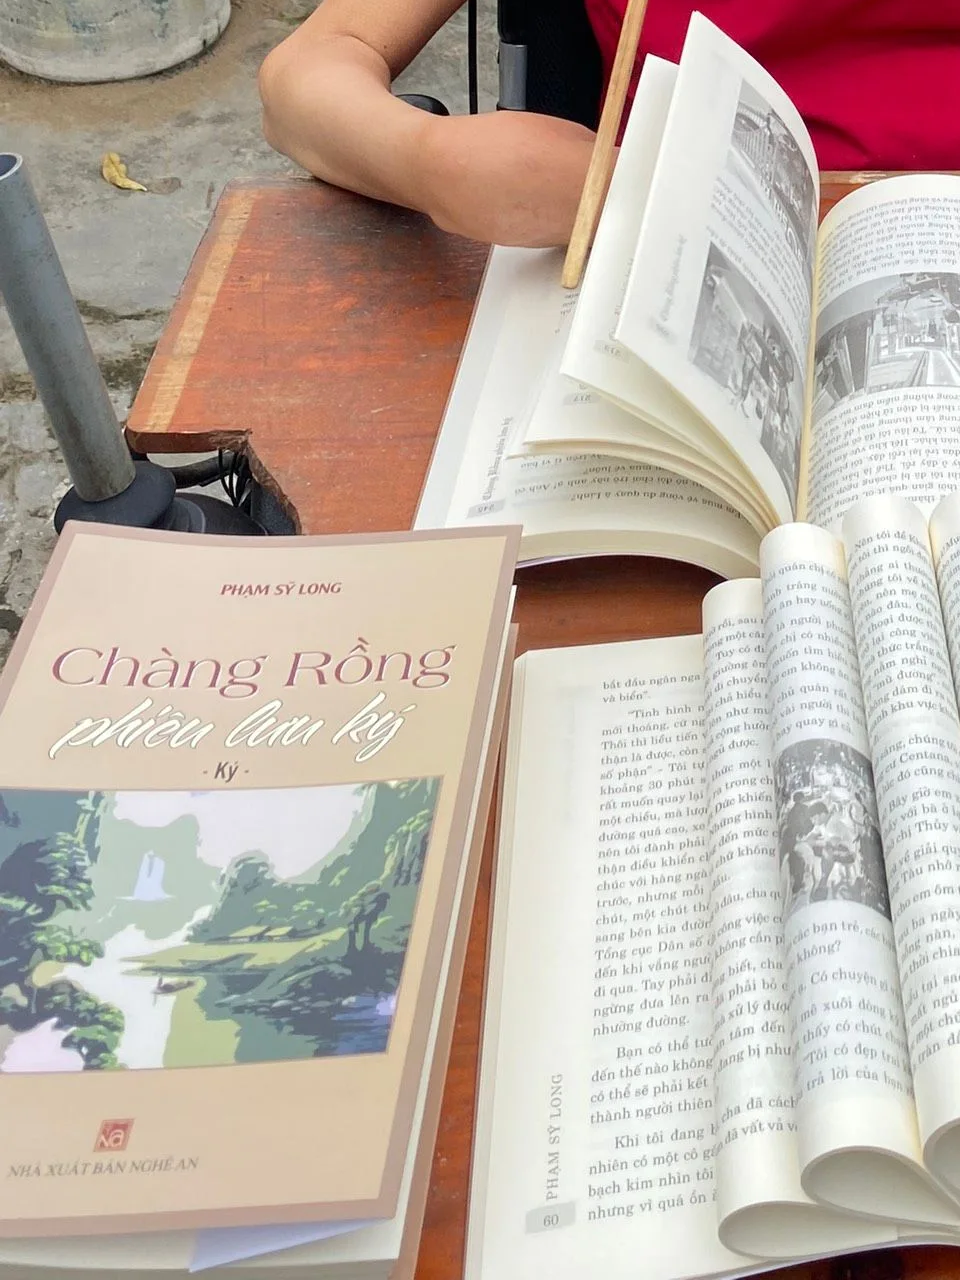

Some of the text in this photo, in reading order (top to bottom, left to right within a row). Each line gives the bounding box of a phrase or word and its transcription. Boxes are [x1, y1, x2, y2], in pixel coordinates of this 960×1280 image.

[220, 581, 343, 599] PHẠM SỸ LONG
[51, 636, 457, 699] Chàng Rồng
[48, 691, 418, 764] phiêu lưu ký
[214, 760, 239, 783] Ký
[591, 1056, 713, 1083] đến thế nào không
[590, 1077, 708, 1103] có thể sẽ phải kết
[590, 1098, 713, 1124] thành người thiên
[545, 1073, 563, 1201] PHẠM SỸ LONG
[543, 1214, 559, 1227] 60
